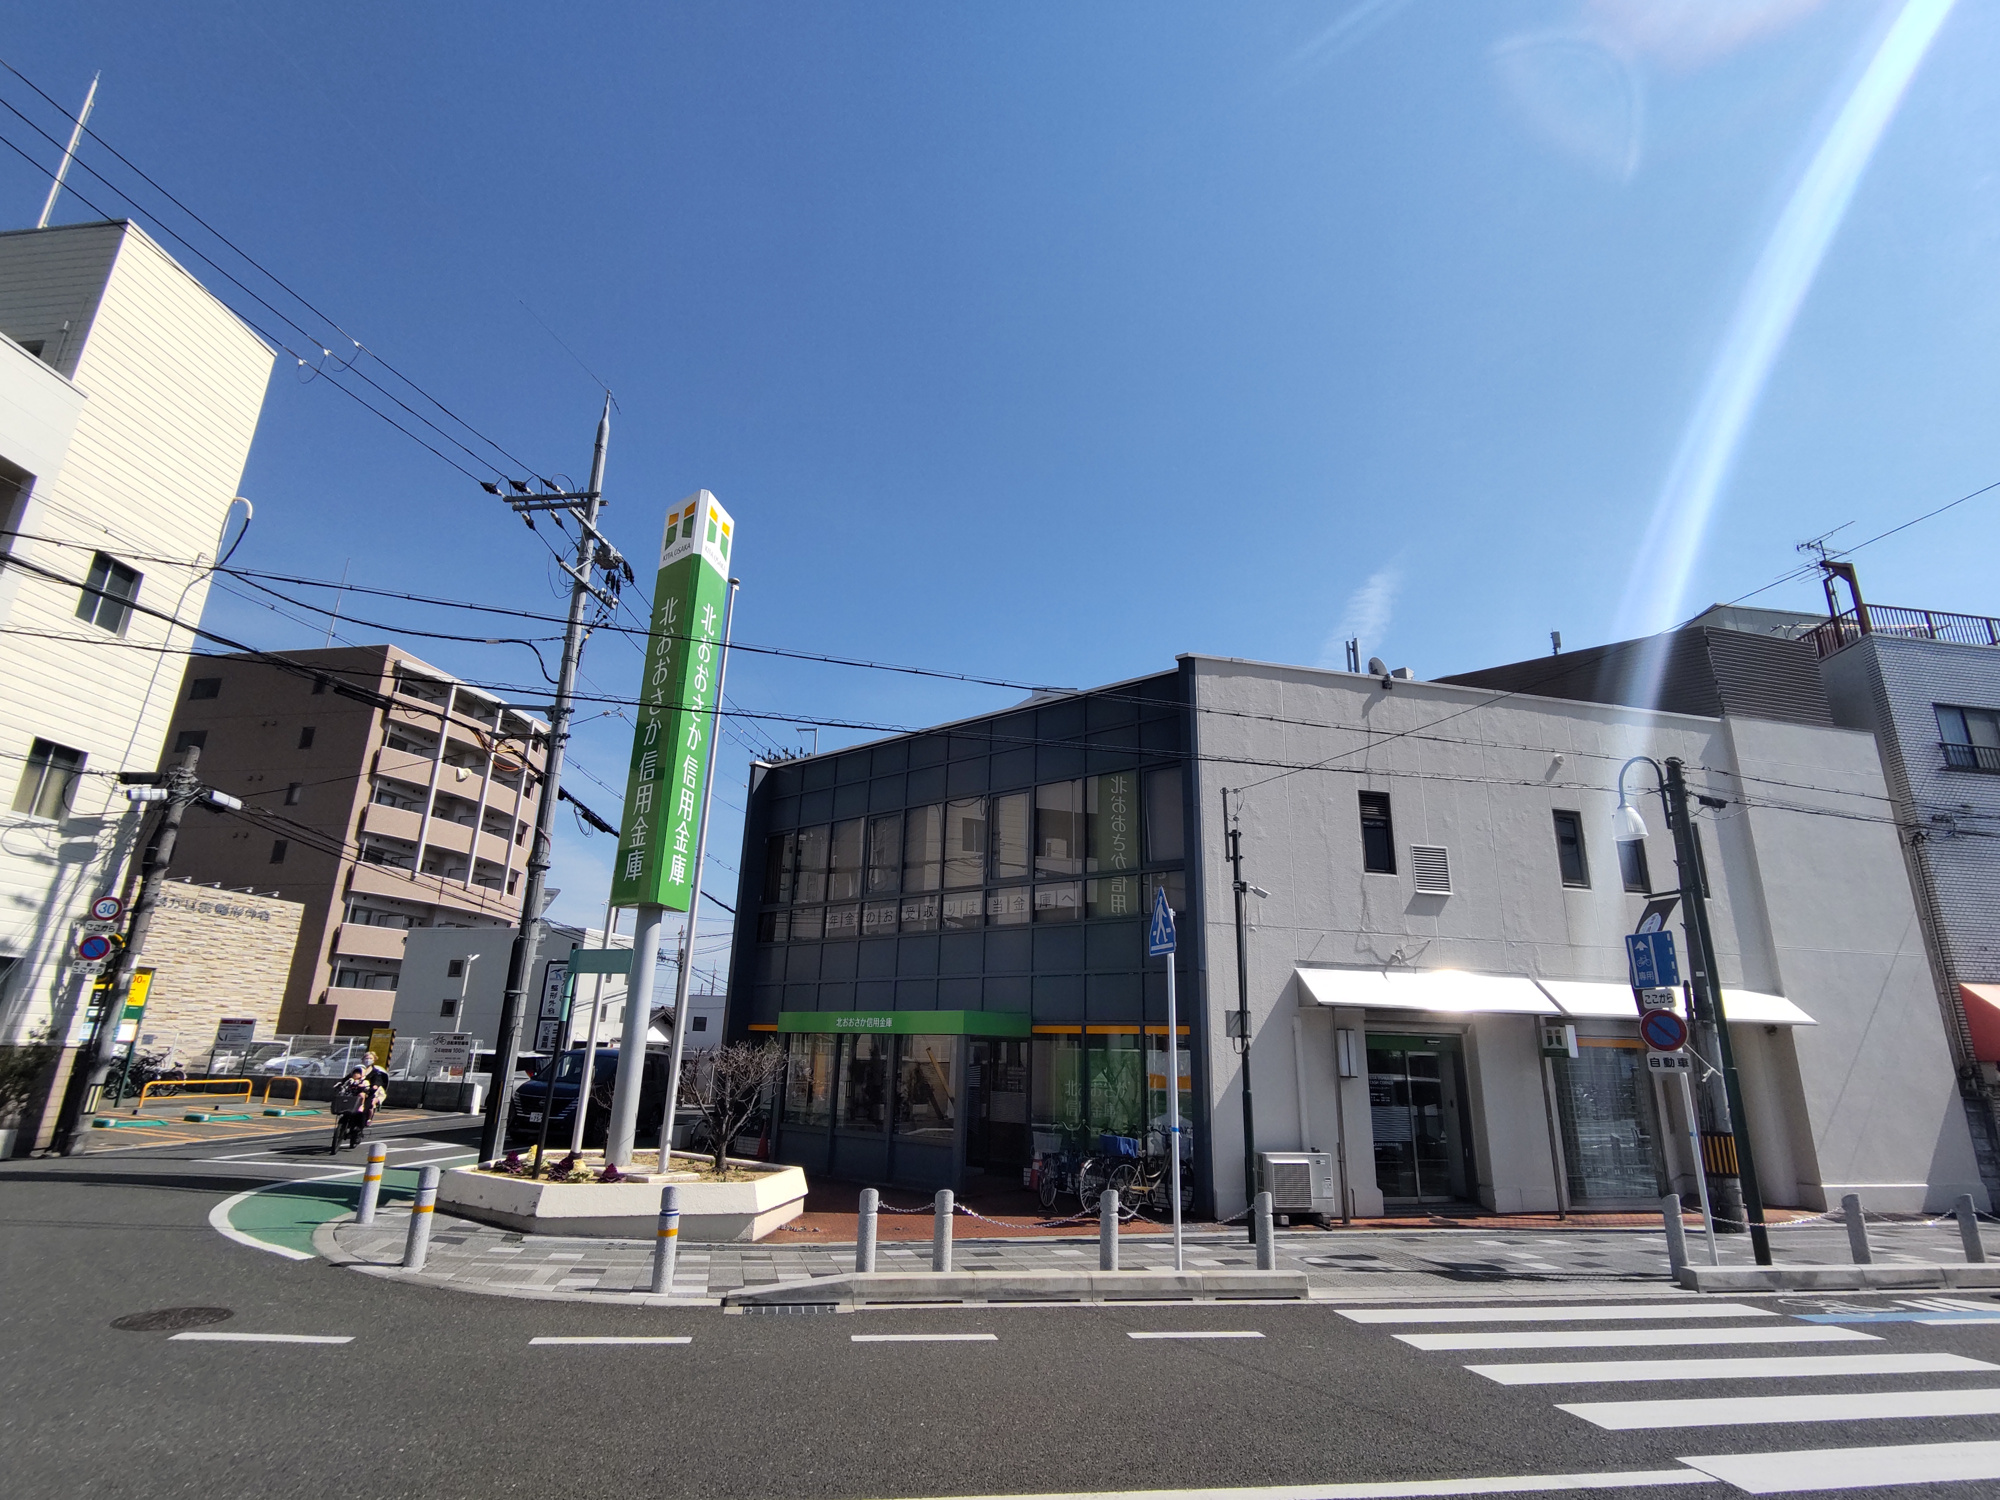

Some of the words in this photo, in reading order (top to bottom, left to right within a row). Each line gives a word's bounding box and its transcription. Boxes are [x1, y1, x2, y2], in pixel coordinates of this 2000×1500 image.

[662, 551, 674, 562] KITA
[673, 542, 691, 556] OSAKA
[624, 596, 679, 882] 北おおさか信用金庫
[668, 602, 717, 886] 北おおさか信用金庫
[98, 902, 116, 915] 30
[828, 893, 1075, 926] 年金のお受取りは当金庫へ
[86, 922, 116, 932] ここから
[71, 966, 103, 974] ここから
[1638, 971, 1655, 981] 専用
[1644, 993, 1673, 1005] ここから
[836, 1017, 893, 1028] 北おおさか信用金庫
[1649, 1057, 1689, 1068] 自動車
